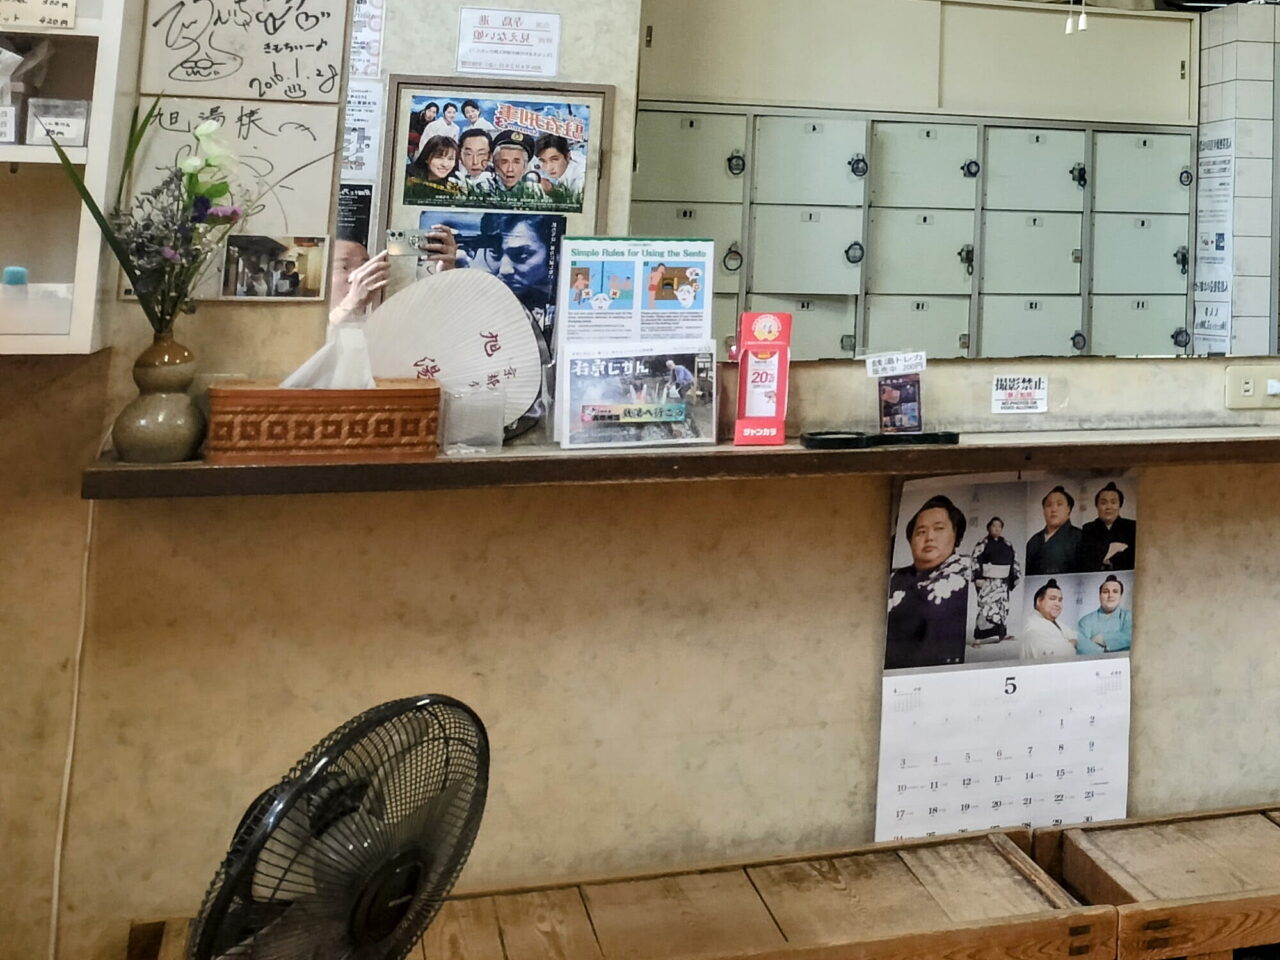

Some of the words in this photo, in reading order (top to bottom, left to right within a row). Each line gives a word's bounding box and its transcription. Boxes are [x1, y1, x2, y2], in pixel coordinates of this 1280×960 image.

[571, 248, 599, 257] Simple
[602, 249, 625, 257] Rules
[628, 249, 639, 257] for
[641, 249, 665, 258] Using
[667, 249, 680, 257] the
[683, 249, 706, 257] Sento
[1004, 676, 1017, 695] 5
